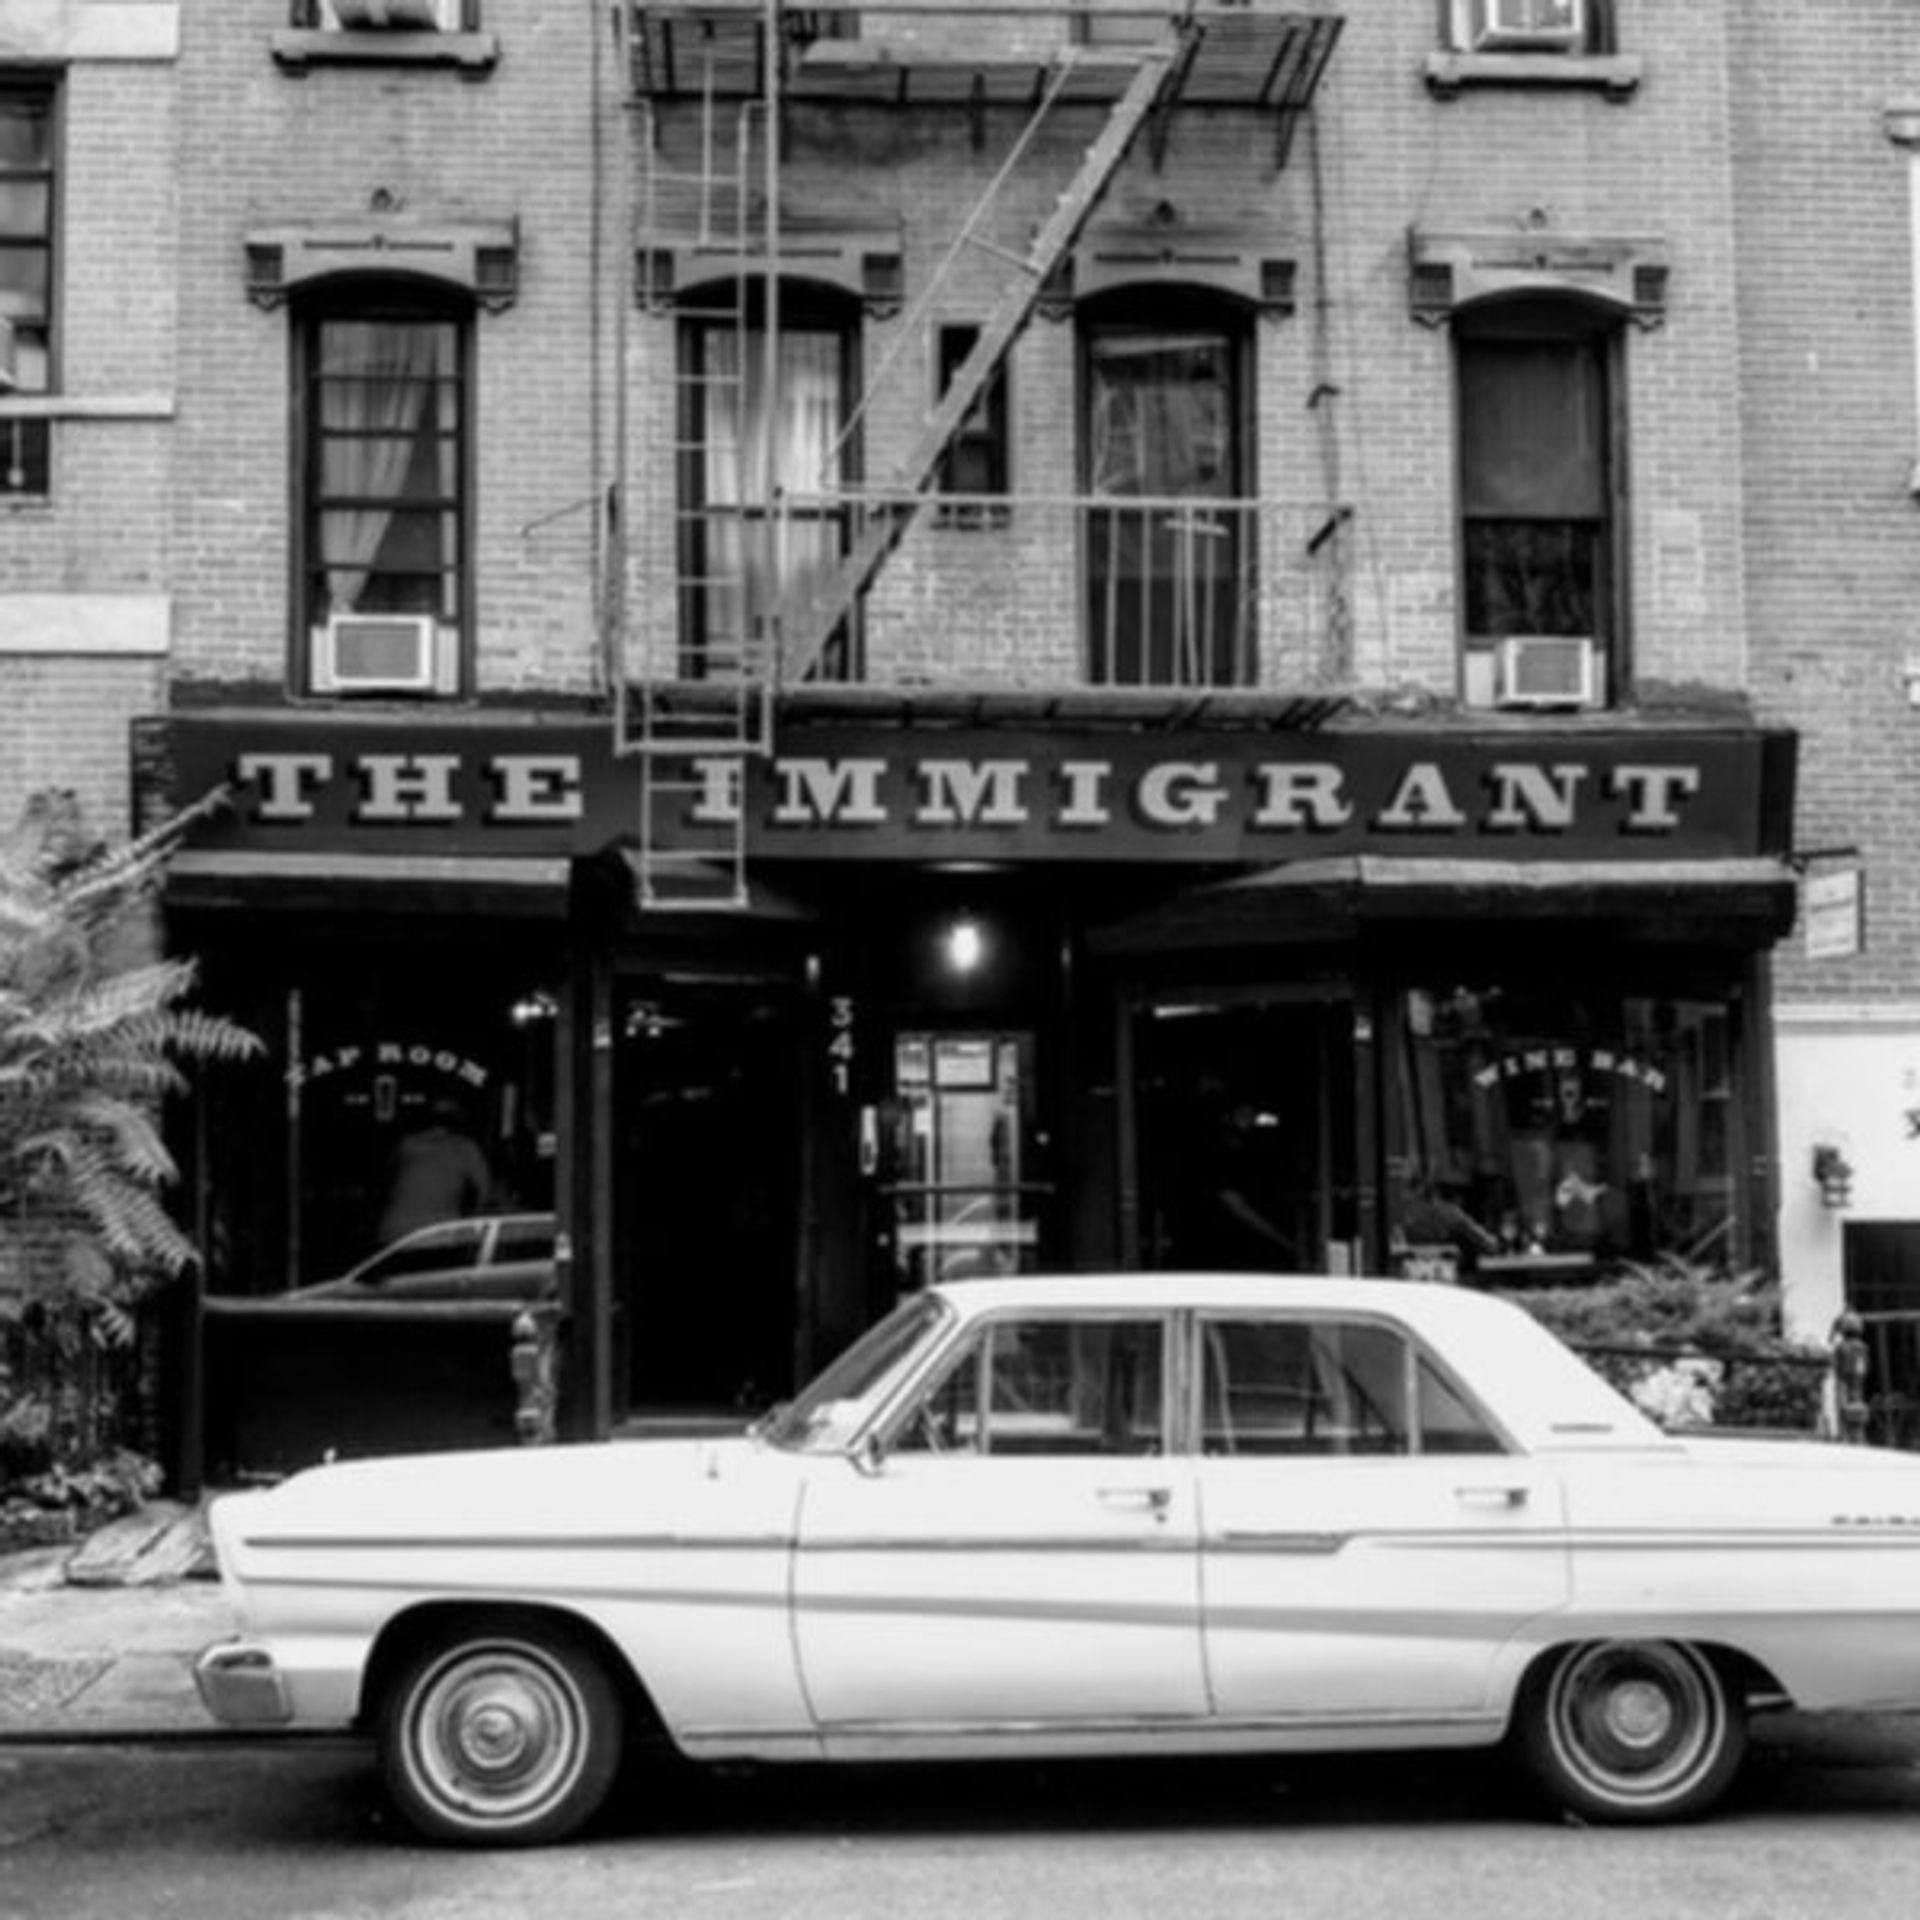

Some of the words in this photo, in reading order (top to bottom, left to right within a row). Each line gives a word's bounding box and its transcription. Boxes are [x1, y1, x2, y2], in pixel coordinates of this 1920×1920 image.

[238, 753, 583, 819] THE
[692, 758, 1700, 827] IMMIGRANT
[377, 1042, 489, 1088] ROOM
[829, 997, 854, 1094] 341
